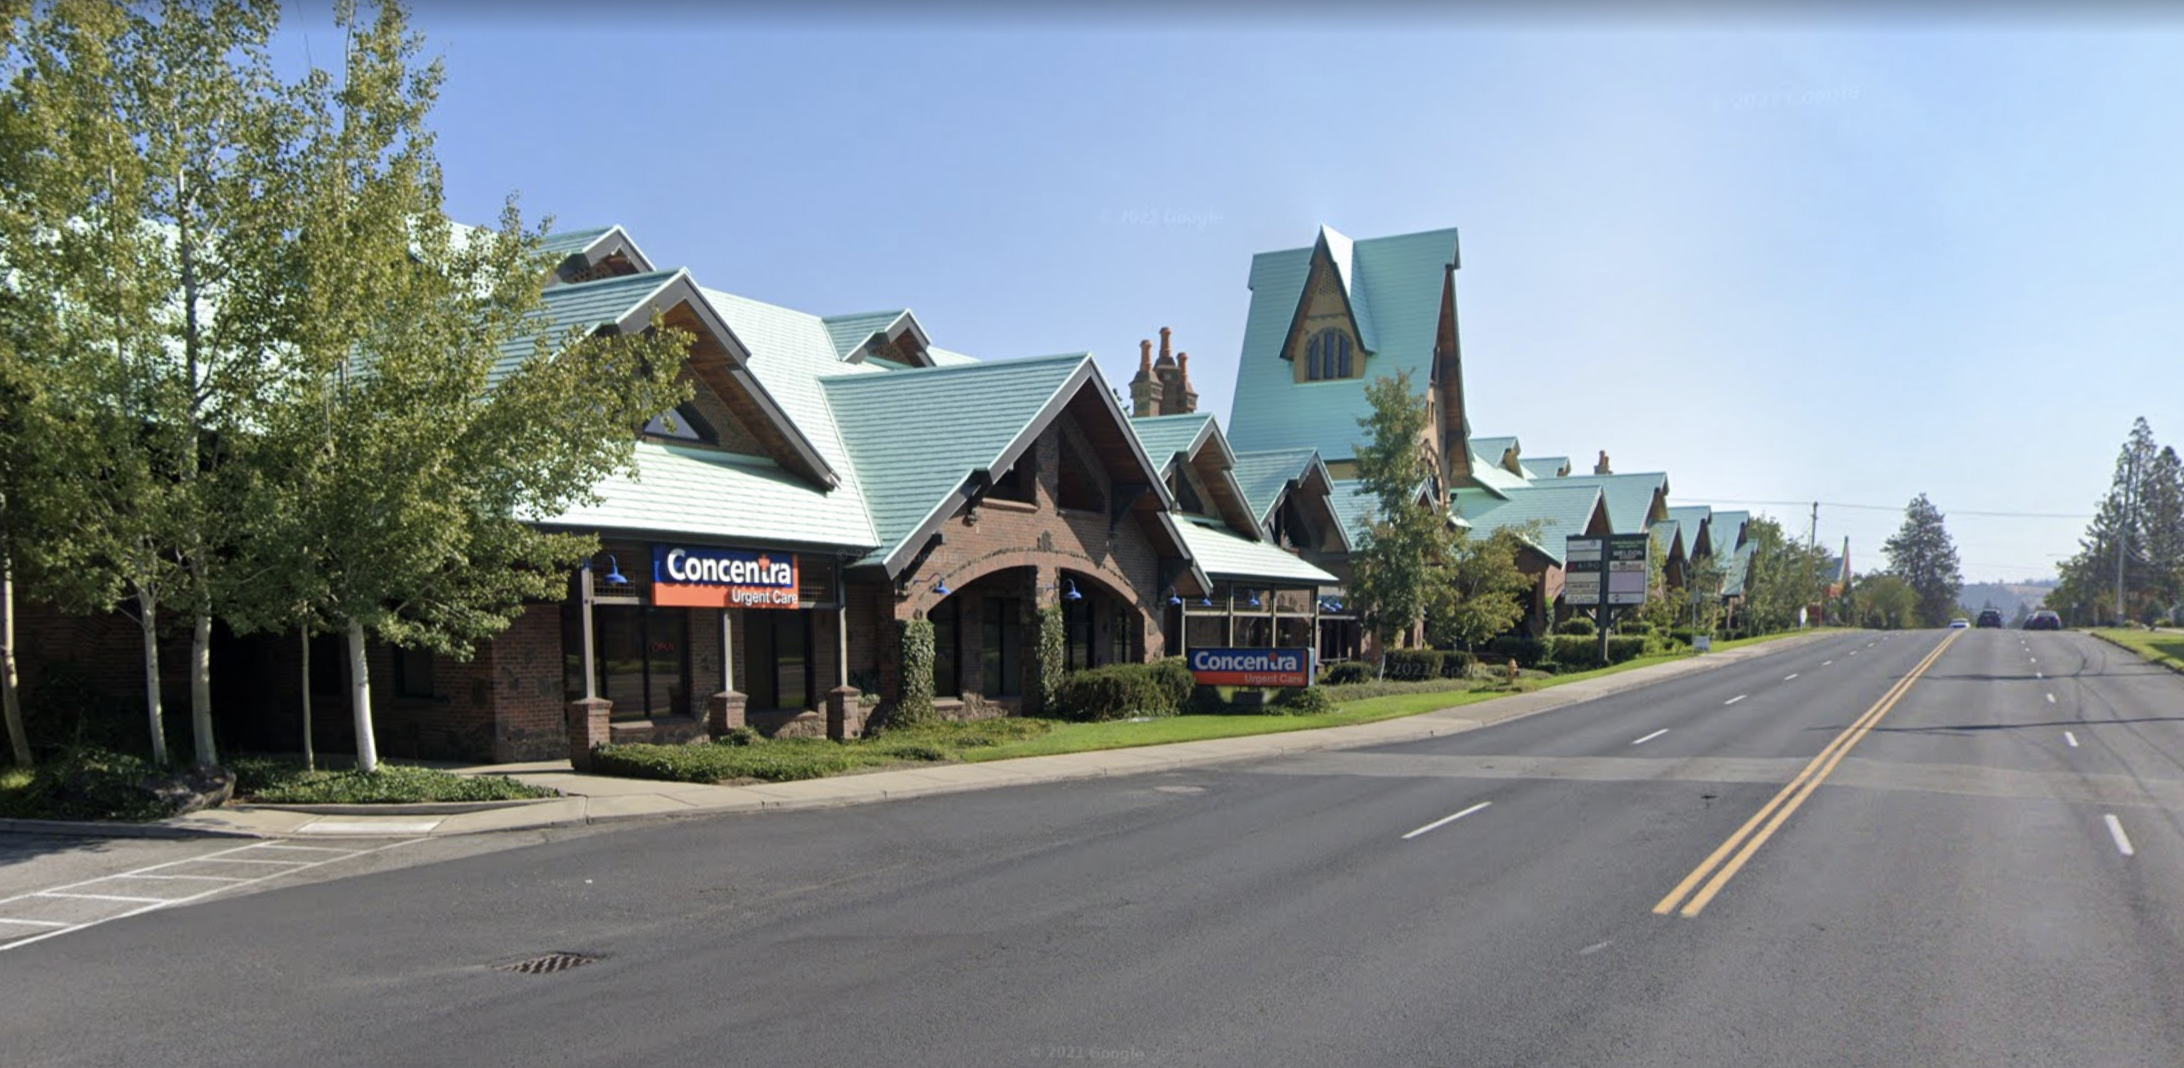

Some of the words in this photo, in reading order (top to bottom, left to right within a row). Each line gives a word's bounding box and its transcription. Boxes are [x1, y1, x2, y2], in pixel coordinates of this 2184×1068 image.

[667, 548, 791, 584] Concentra
[731, 588, 770, 606] Urgent
[773, 590, 798, 604] Care
[1194, 651, 1297, 671] Concentra
[1245, 674, 1277, 684] Urgent
[1280, 674, 1303, 683] Care
